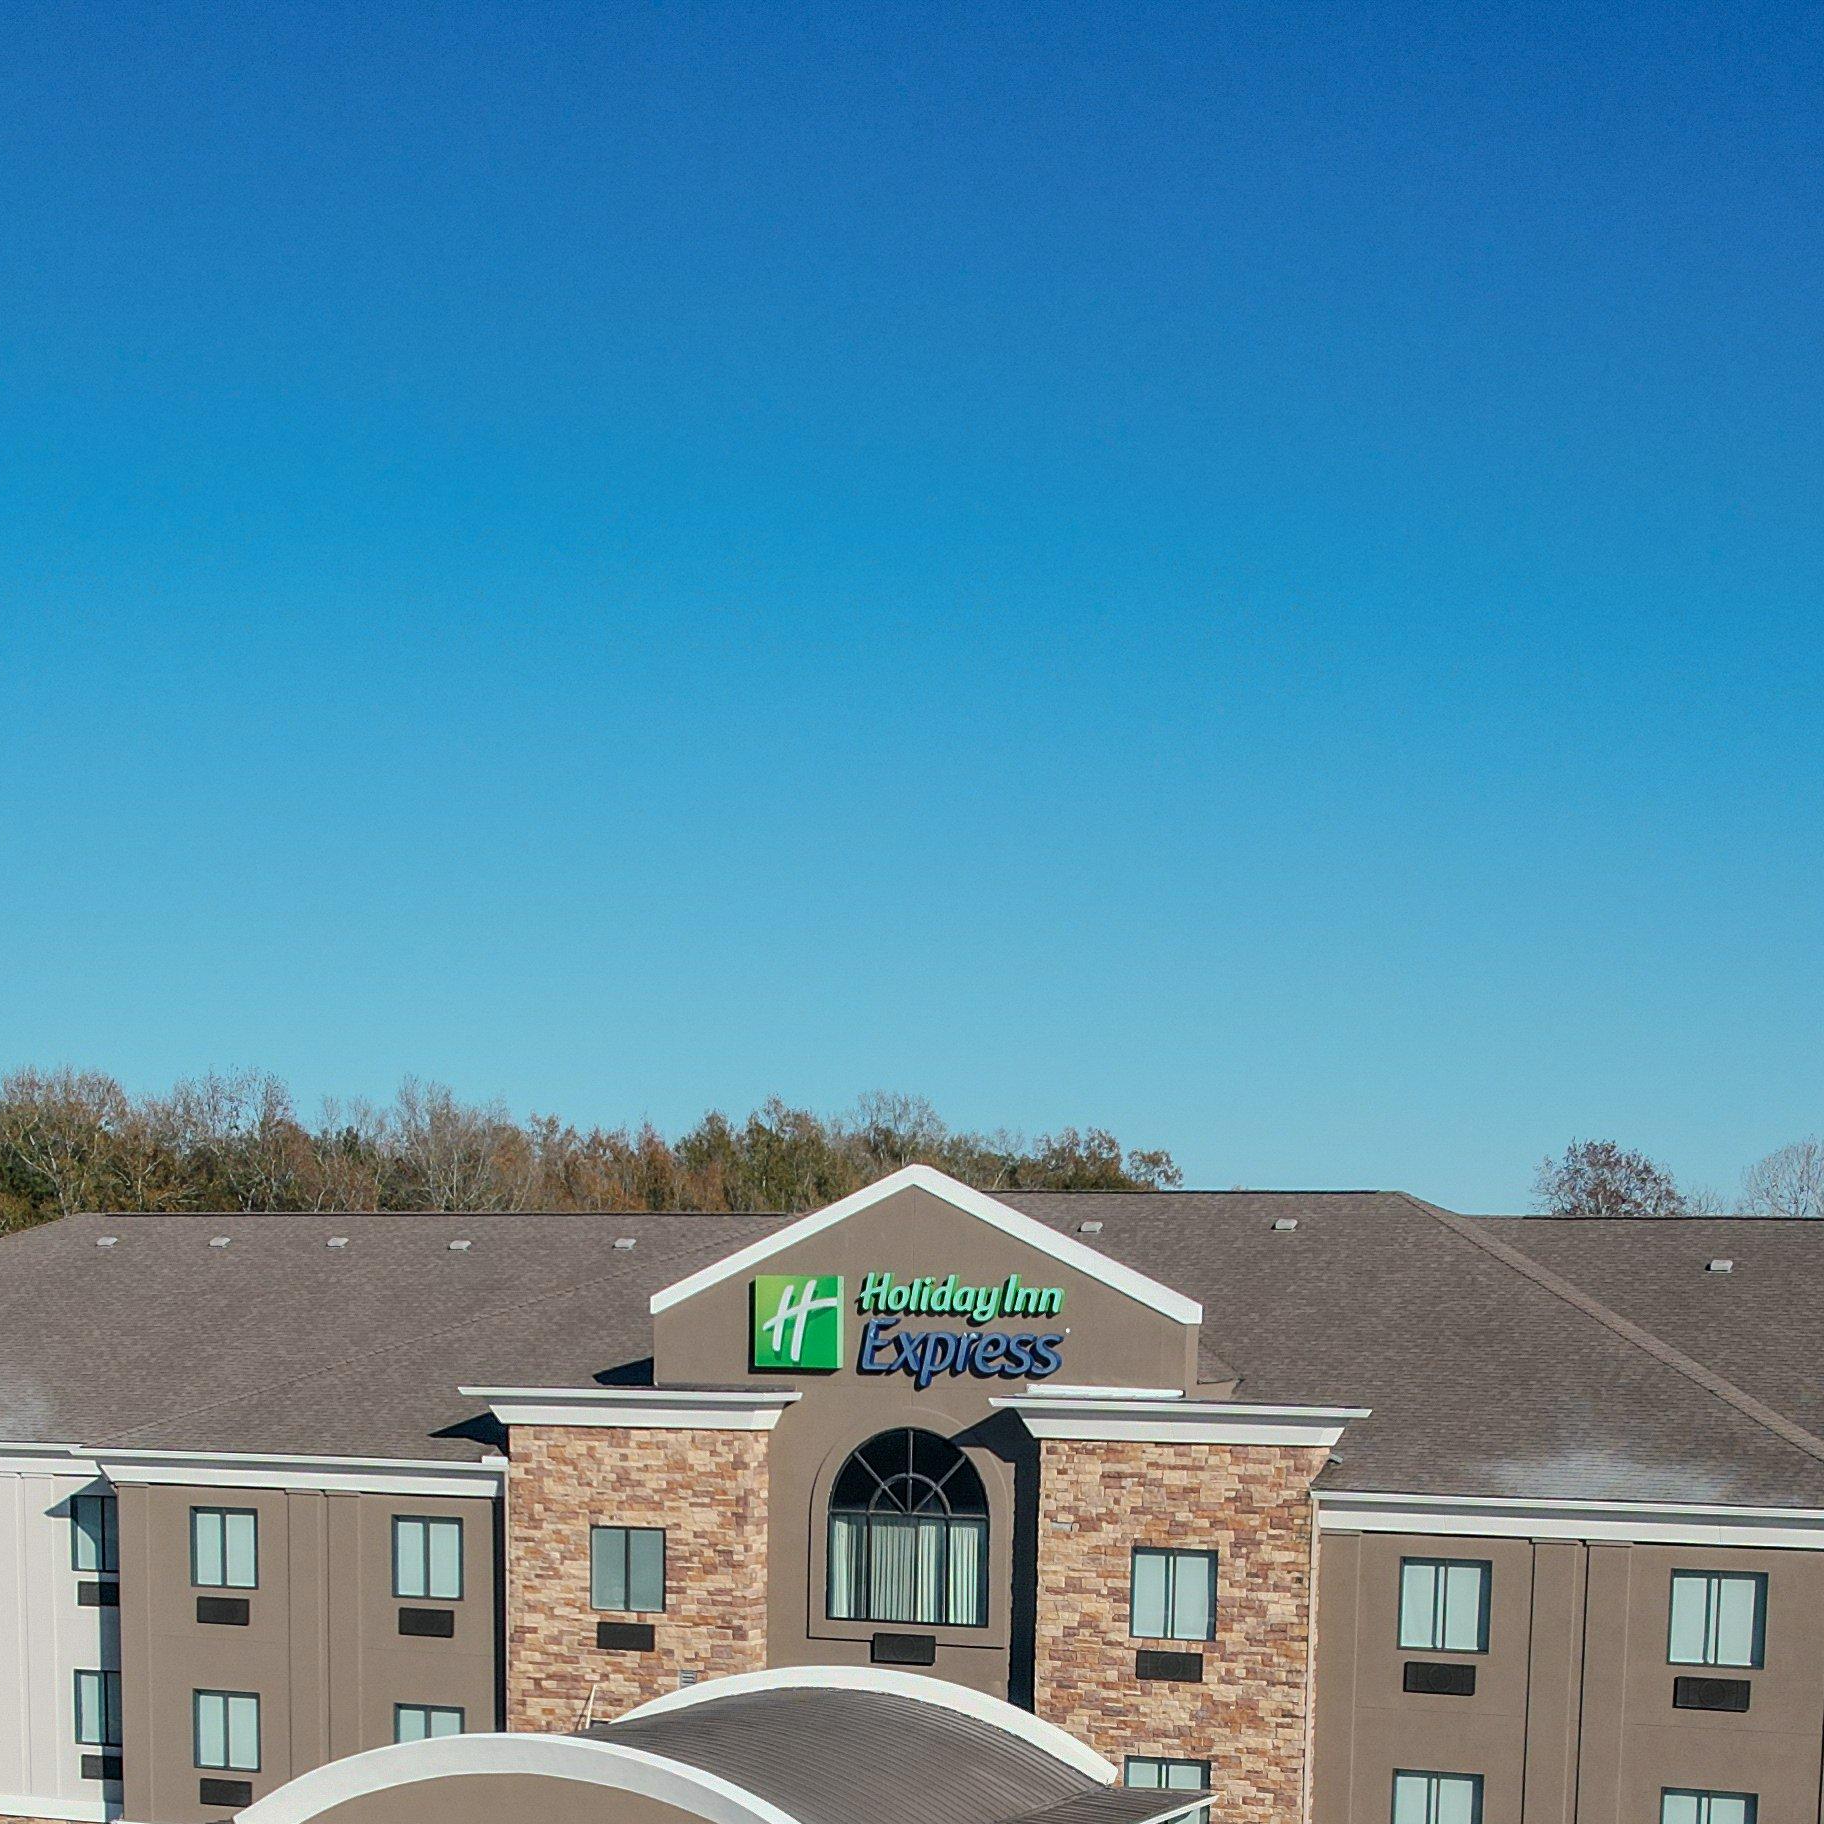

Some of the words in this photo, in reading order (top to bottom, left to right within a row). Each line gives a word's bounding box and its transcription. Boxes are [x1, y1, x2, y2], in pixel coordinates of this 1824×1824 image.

[859, 1272, 1000, 1322] Holiday
[1002, 1273, 1065, 1314] Inn
[861, 1317, 1064, 1389] Express
